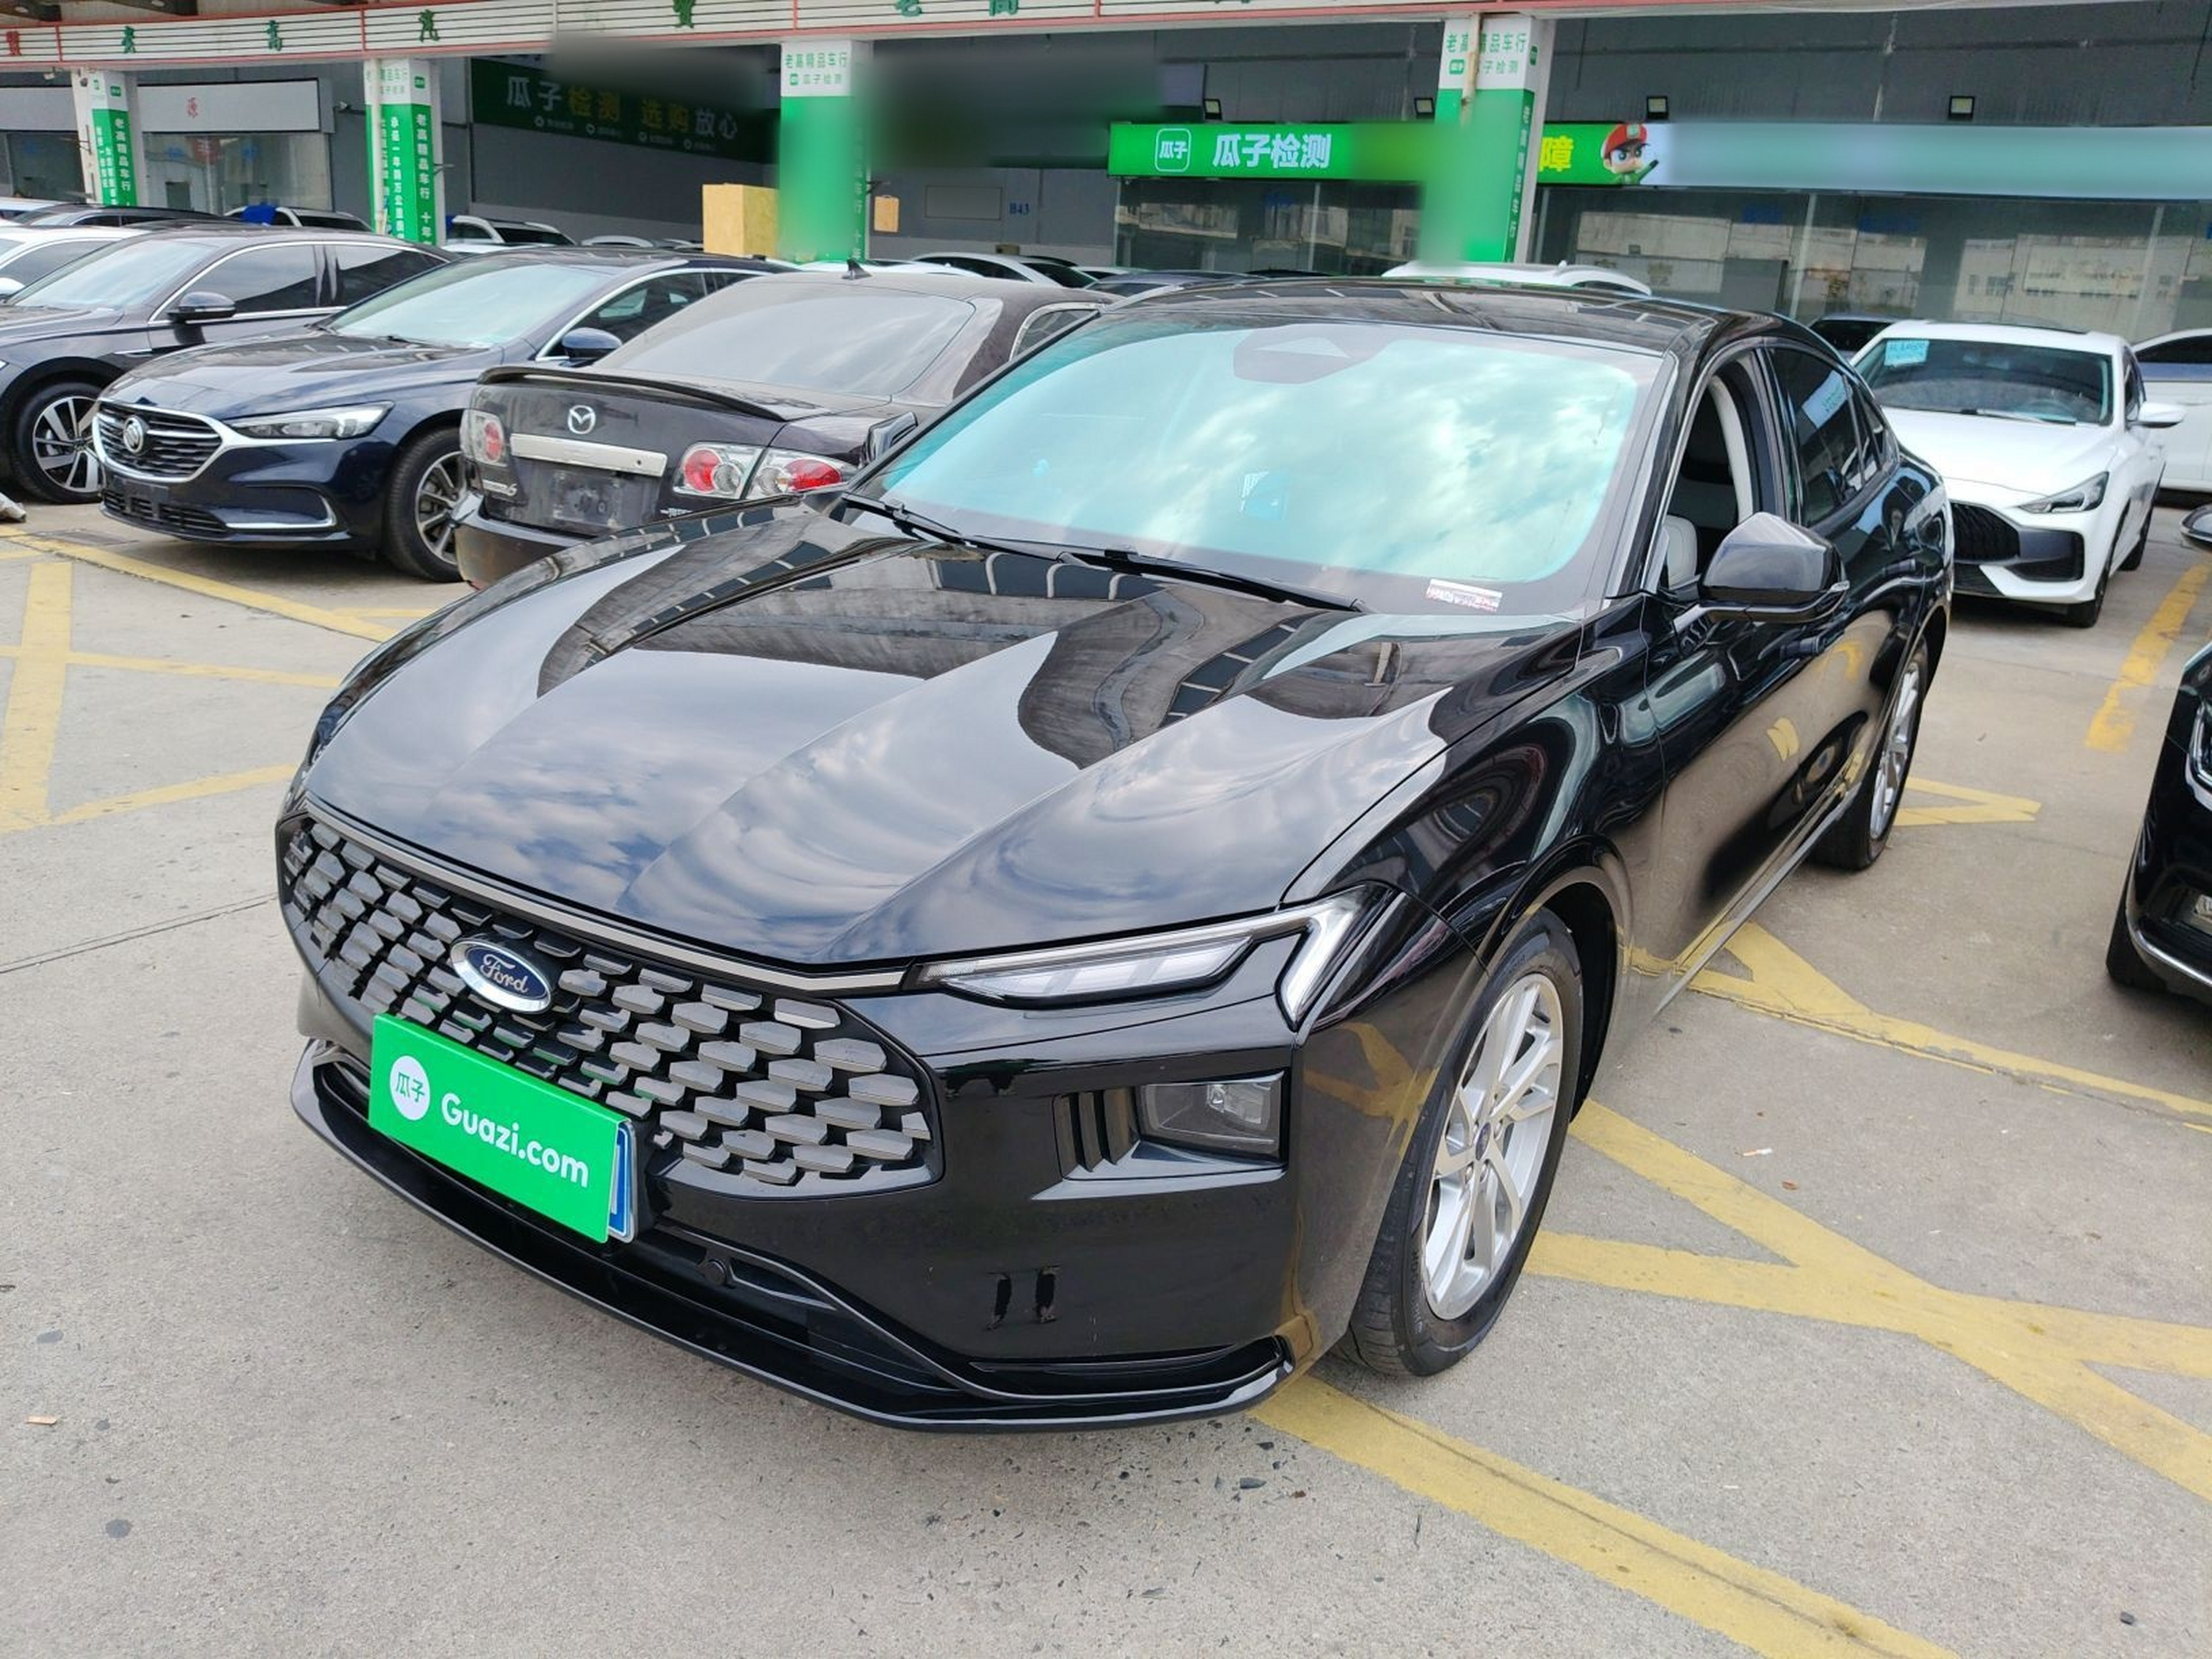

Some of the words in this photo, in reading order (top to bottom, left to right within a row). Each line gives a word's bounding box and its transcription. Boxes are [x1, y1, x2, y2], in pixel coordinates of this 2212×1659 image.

[1160, 141, 1188, 158] 瓜子
[1213, 134, 1332, 169] 瓜子检测
[480, 954, 528, 993] Ford
[395, 1071, 425, 1103] 瓜子
[441, 1093, 589, 1188] Guazi.com
